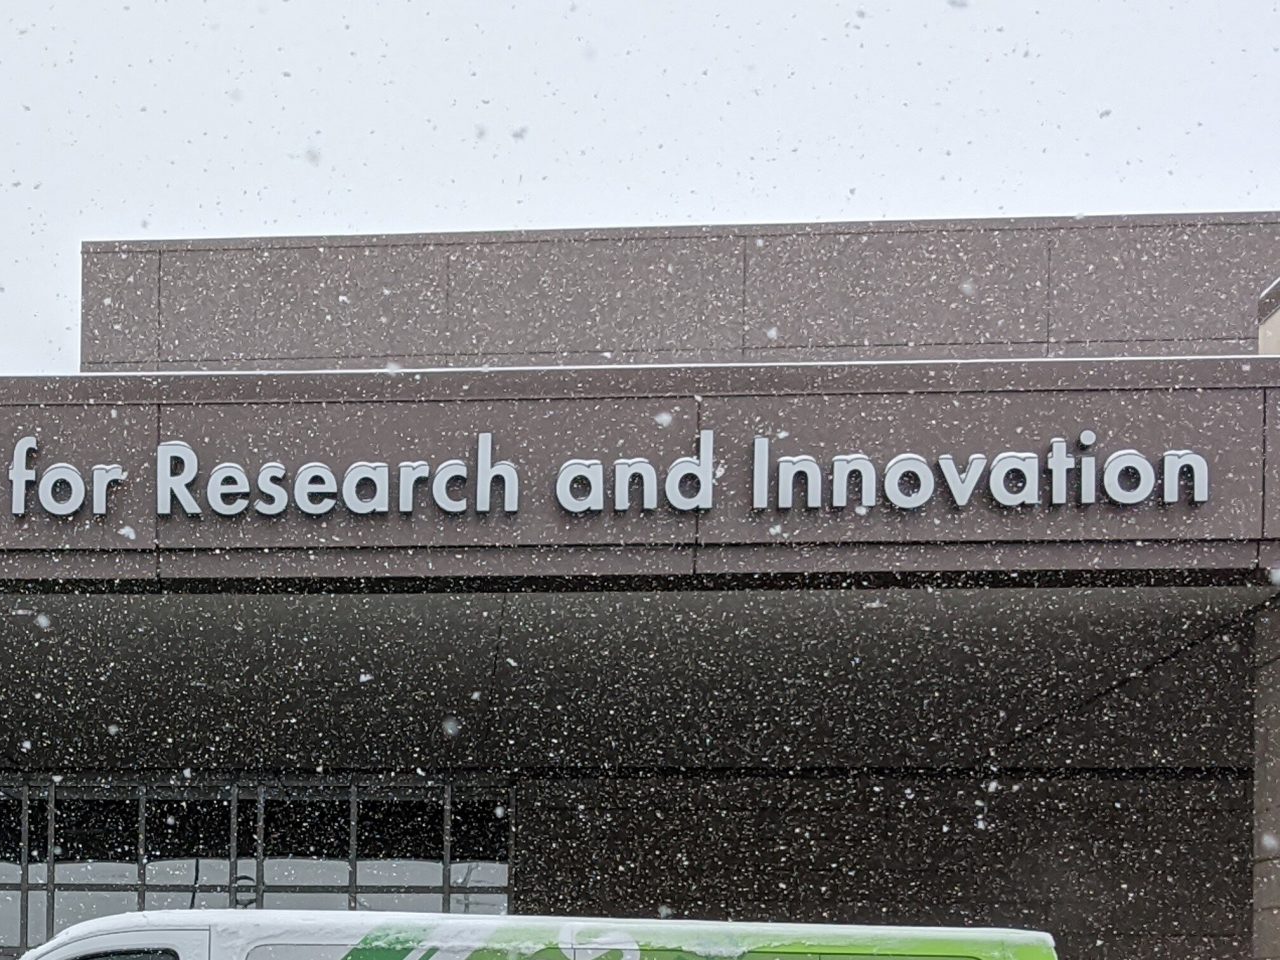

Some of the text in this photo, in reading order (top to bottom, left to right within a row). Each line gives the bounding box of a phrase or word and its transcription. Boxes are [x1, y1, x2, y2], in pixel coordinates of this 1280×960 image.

[8, 436, 124, 516] for
[155, 432, 520, 516] Research
[556, 430, 715, 514] and
[753, 429, 1210, 512] Innovation
